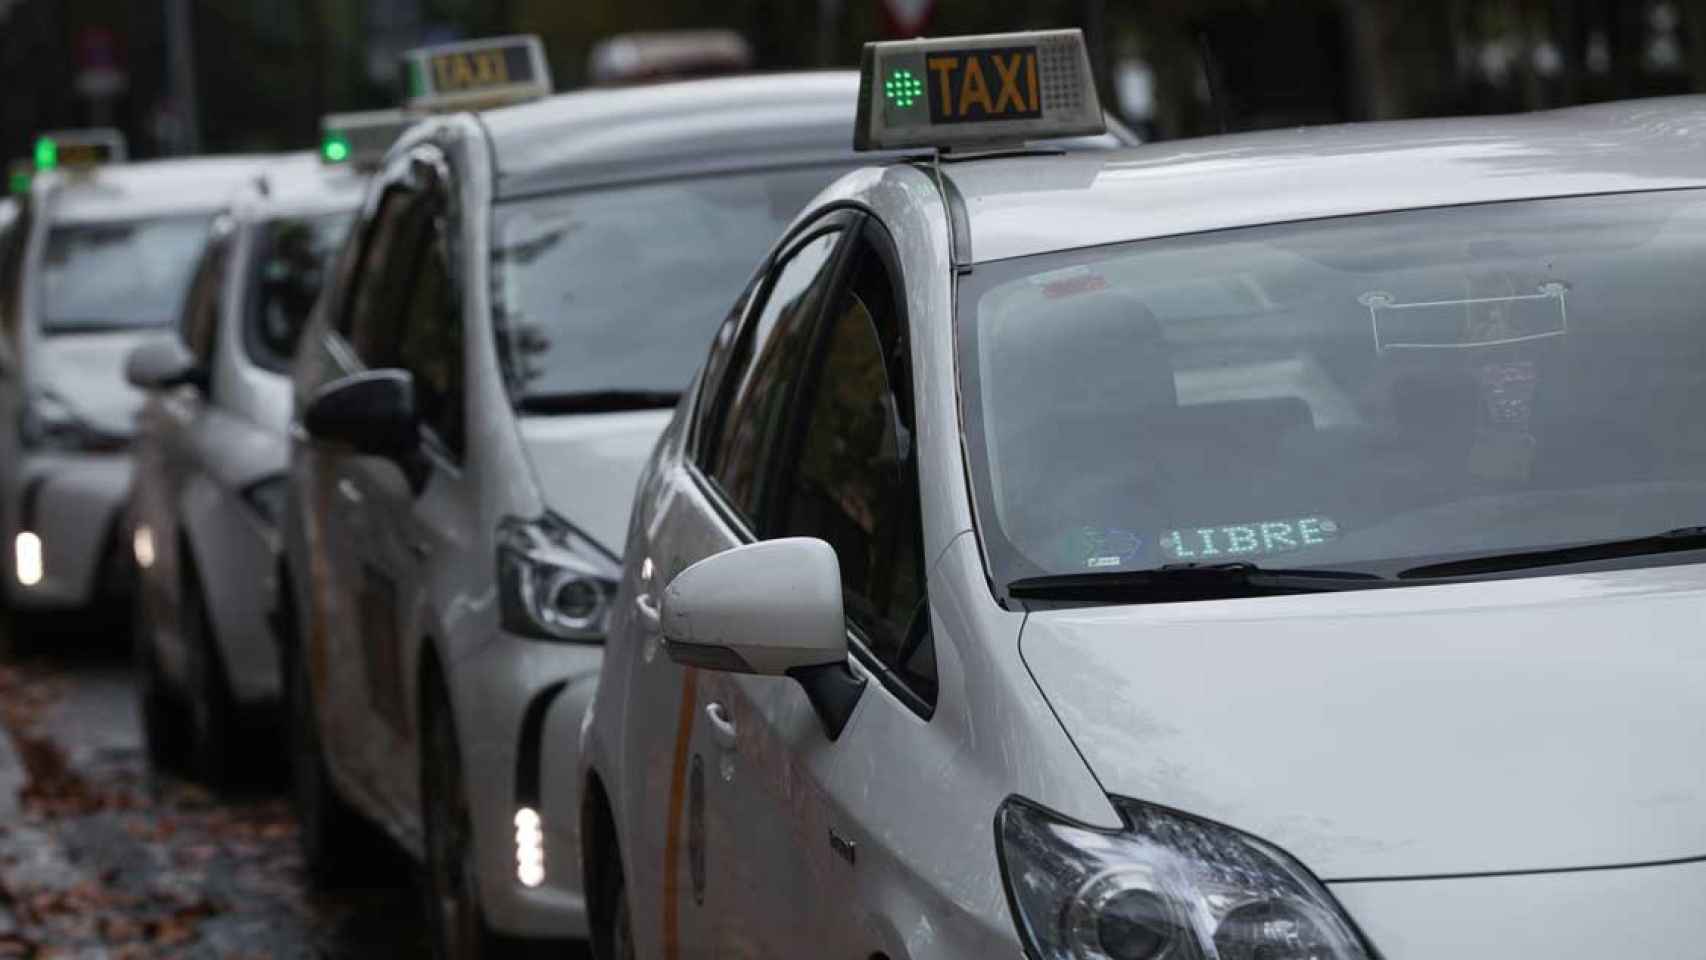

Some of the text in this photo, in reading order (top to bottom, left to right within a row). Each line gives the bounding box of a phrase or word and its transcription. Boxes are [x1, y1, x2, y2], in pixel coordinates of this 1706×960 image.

[432, 50, 507, 89] TAXI
[928, 54, 1038, 115] TAXI
[1171, 518, 1324, 557] LIBRE
